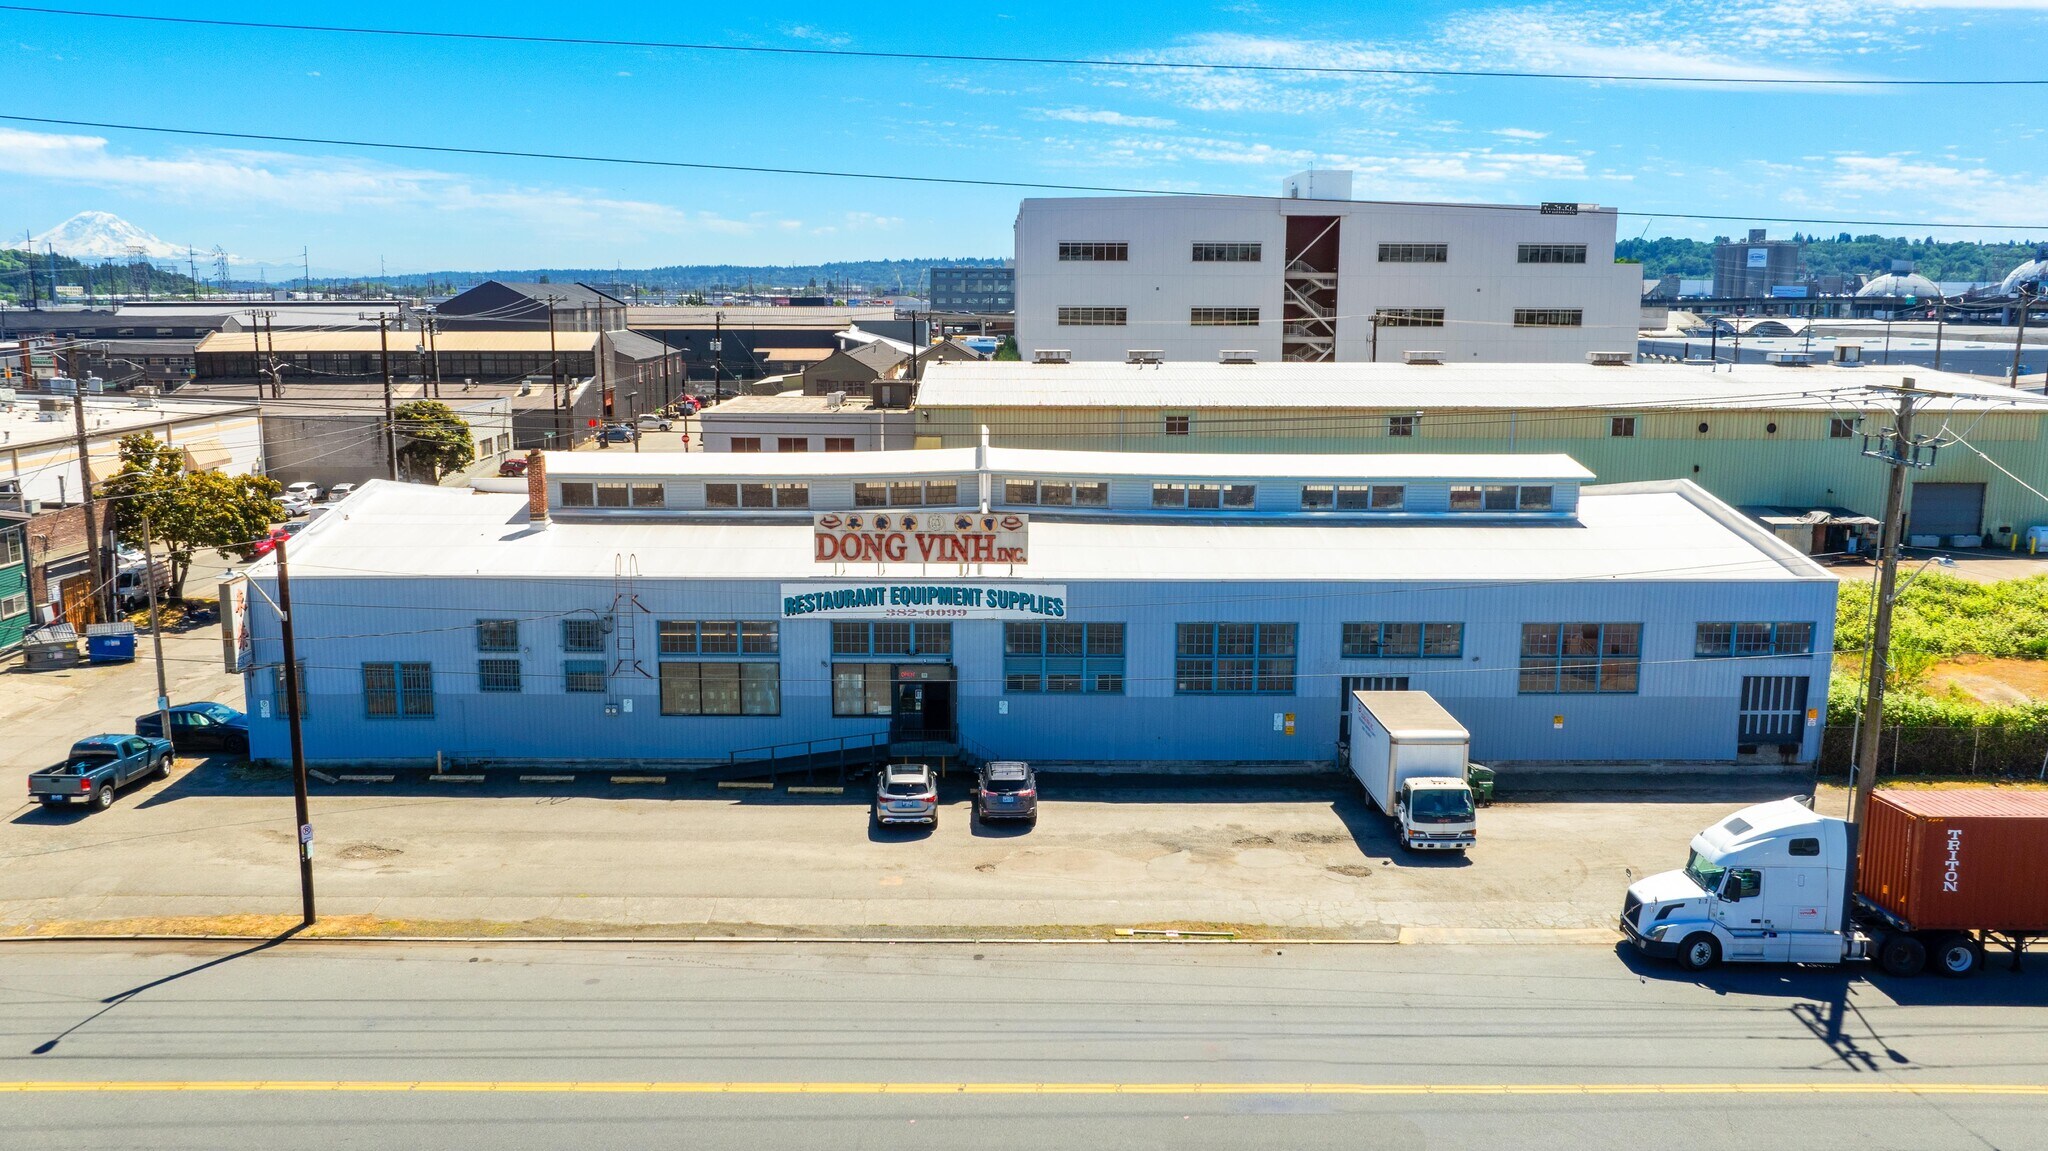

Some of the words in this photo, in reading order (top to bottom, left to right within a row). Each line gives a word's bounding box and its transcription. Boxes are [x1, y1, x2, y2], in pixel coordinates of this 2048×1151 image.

[815, 533, 907, 561] DONG
[915, 534, 996, 562] VINH
[997, 547, 1027, 562] INC.
[784, 587, 886, 616] RESTAURANT
[890, 586, 983, 607] EQUIPMENT
[986, 589, 1064, 617] SUPPLIES
[1942, 829, 1962, 892] TRITON
